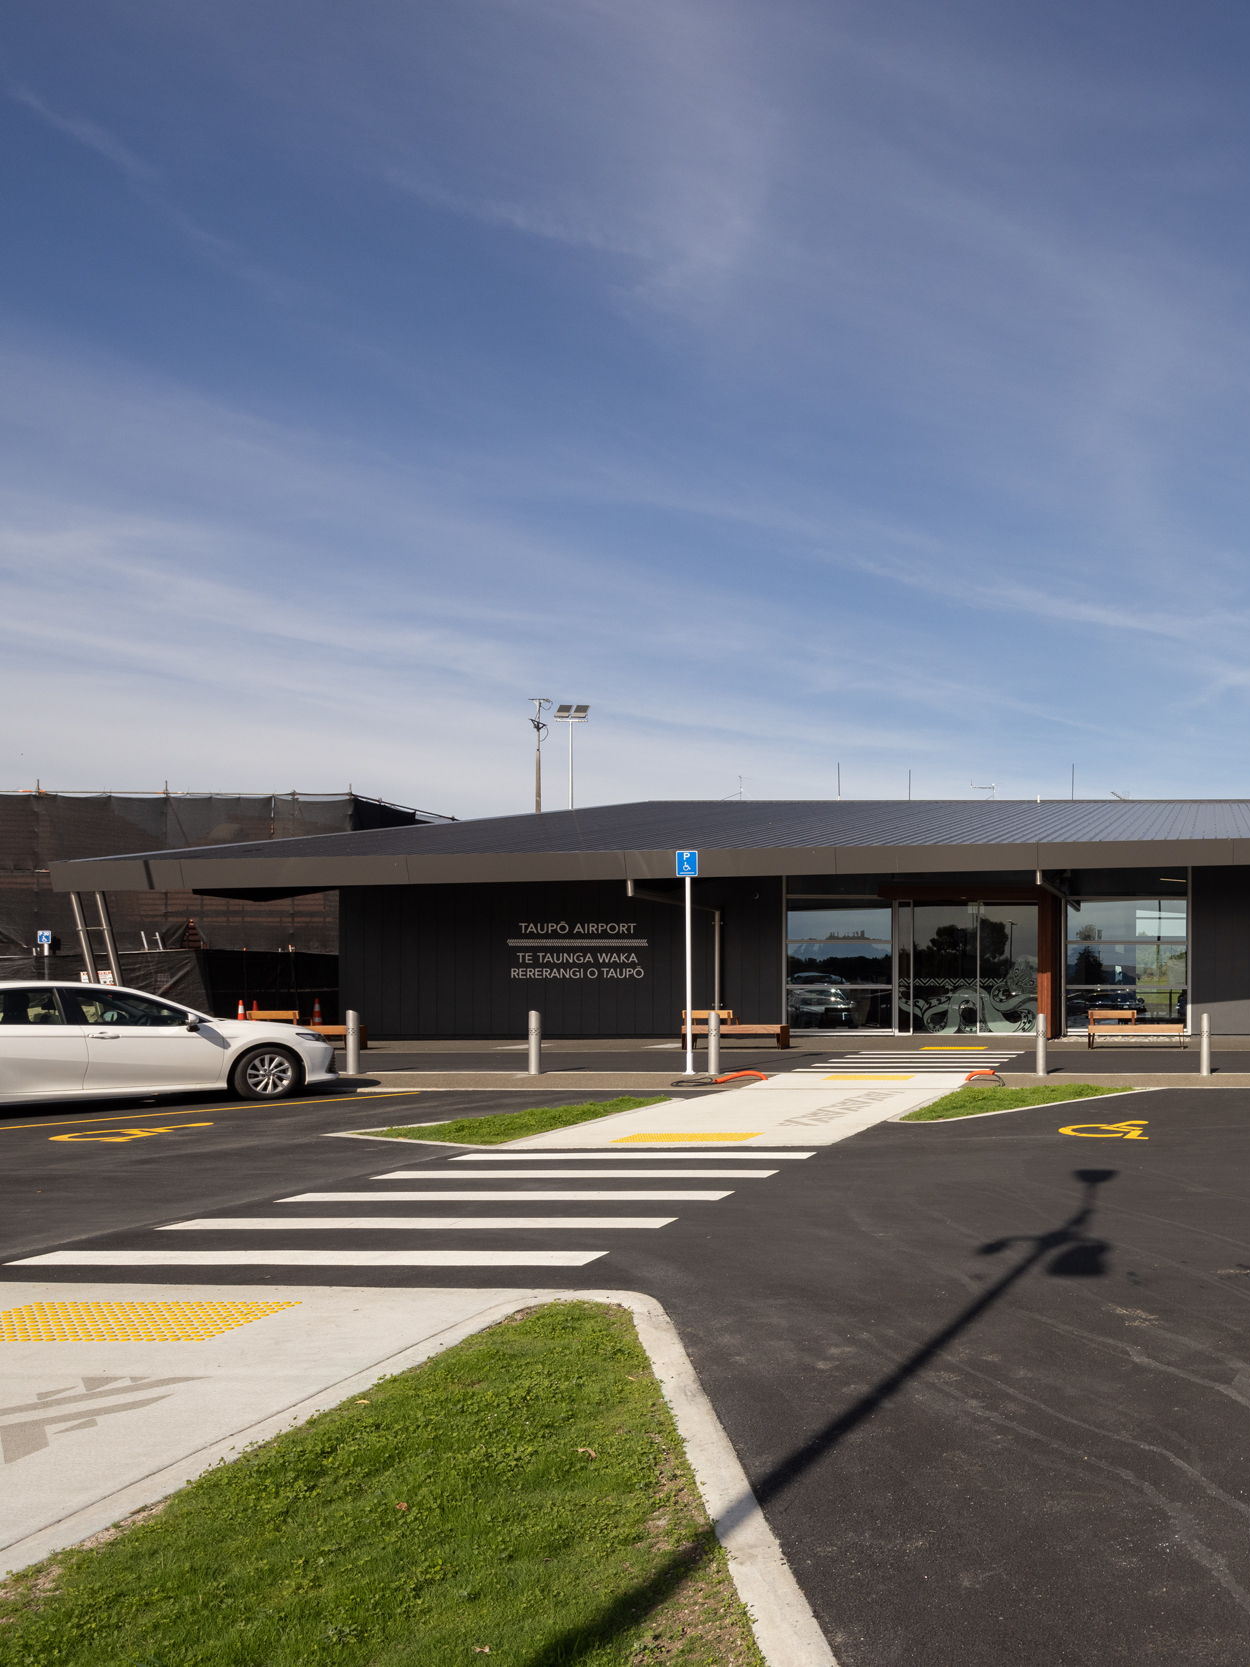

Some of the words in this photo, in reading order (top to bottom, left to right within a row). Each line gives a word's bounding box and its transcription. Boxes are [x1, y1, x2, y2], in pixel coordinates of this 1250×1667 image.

[683, 852, 691, 861] P
[518, 921, 569, 934] TAUPŌ
[573, 923, 637, 934] AIRPORT
[516, 953, 533, 964] TE
[537, 953, 594, 964] TAUNGA
[597, 953, 638, 963] WAKA
[510, 968, 584, 979] RERERANGI
[587, 968, 598, 979] O
[601, 966, 645, 979] TAUPŌ
